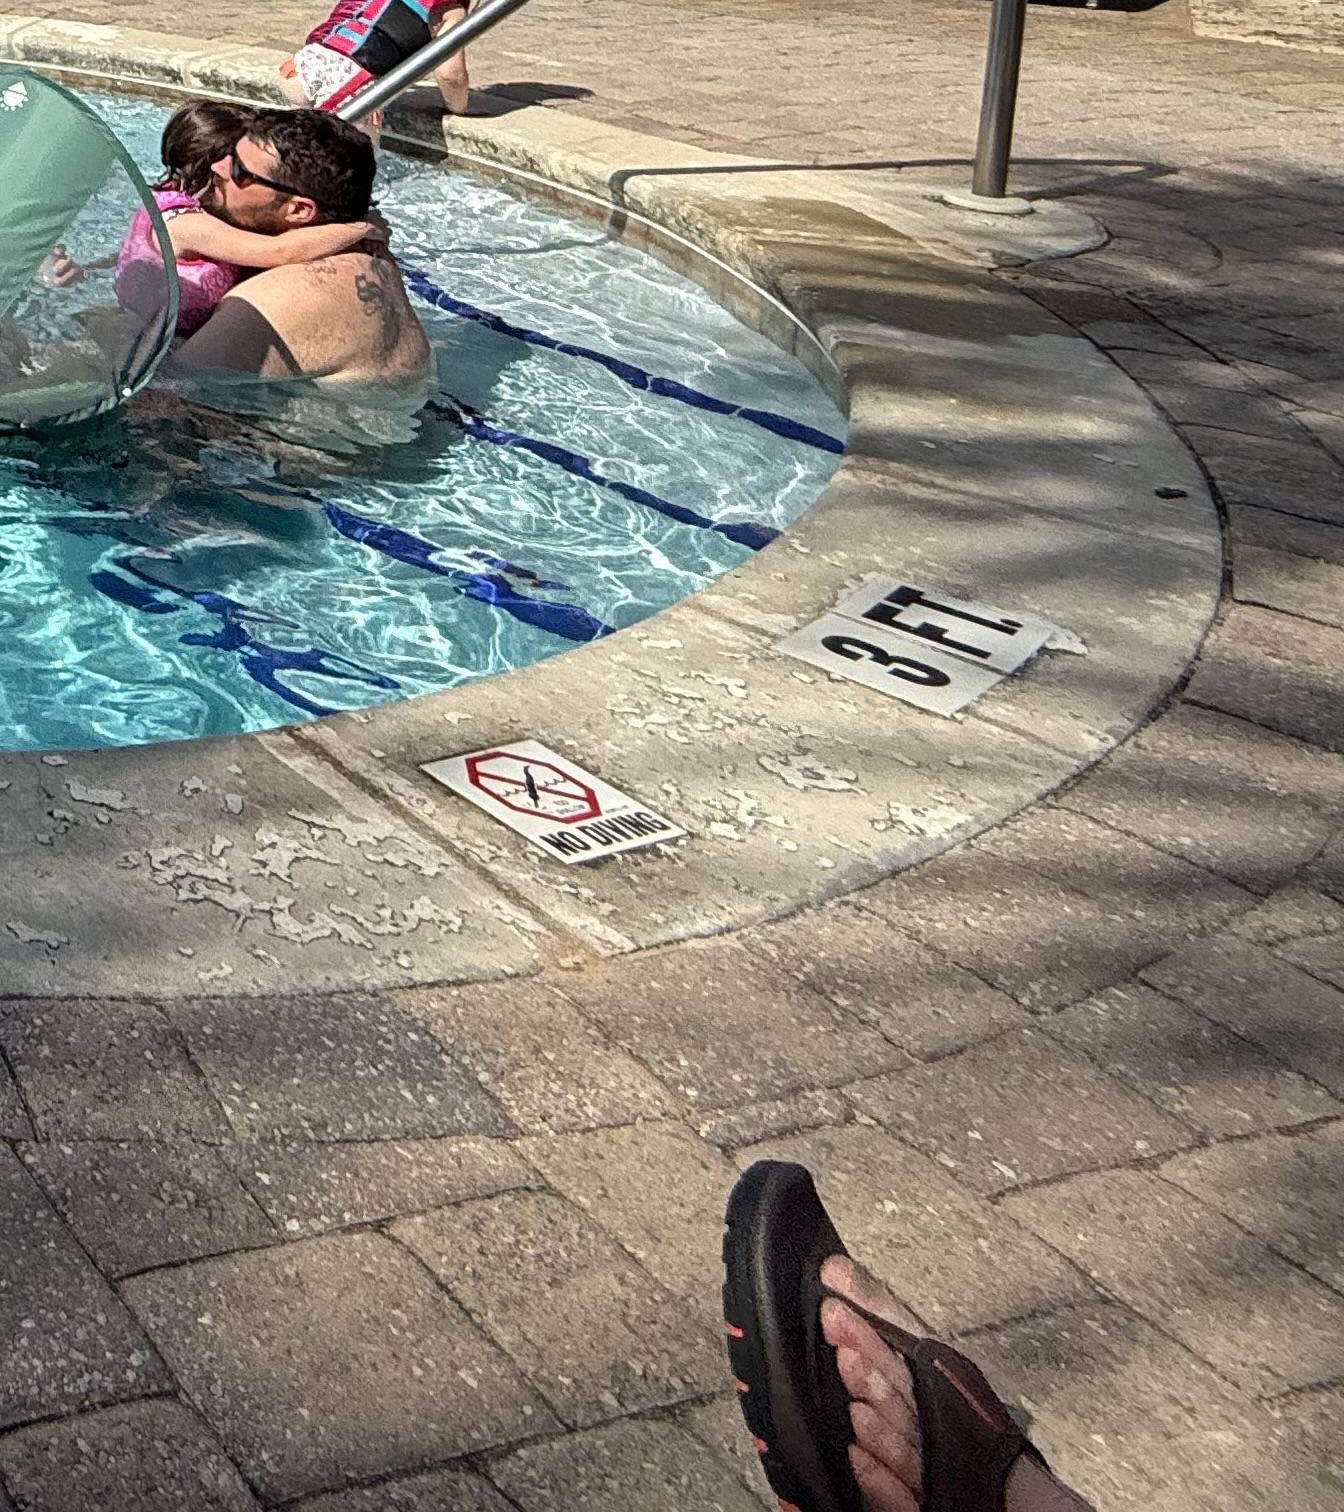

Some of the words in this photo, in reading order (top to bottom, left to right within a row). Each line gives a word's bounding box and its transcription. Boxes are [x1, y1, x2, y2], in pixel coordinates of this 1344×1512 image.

[821, 635, 951, 687] 3
[539, 831, 591, 856] NO
[576, 811, 671, 846] DIVING
